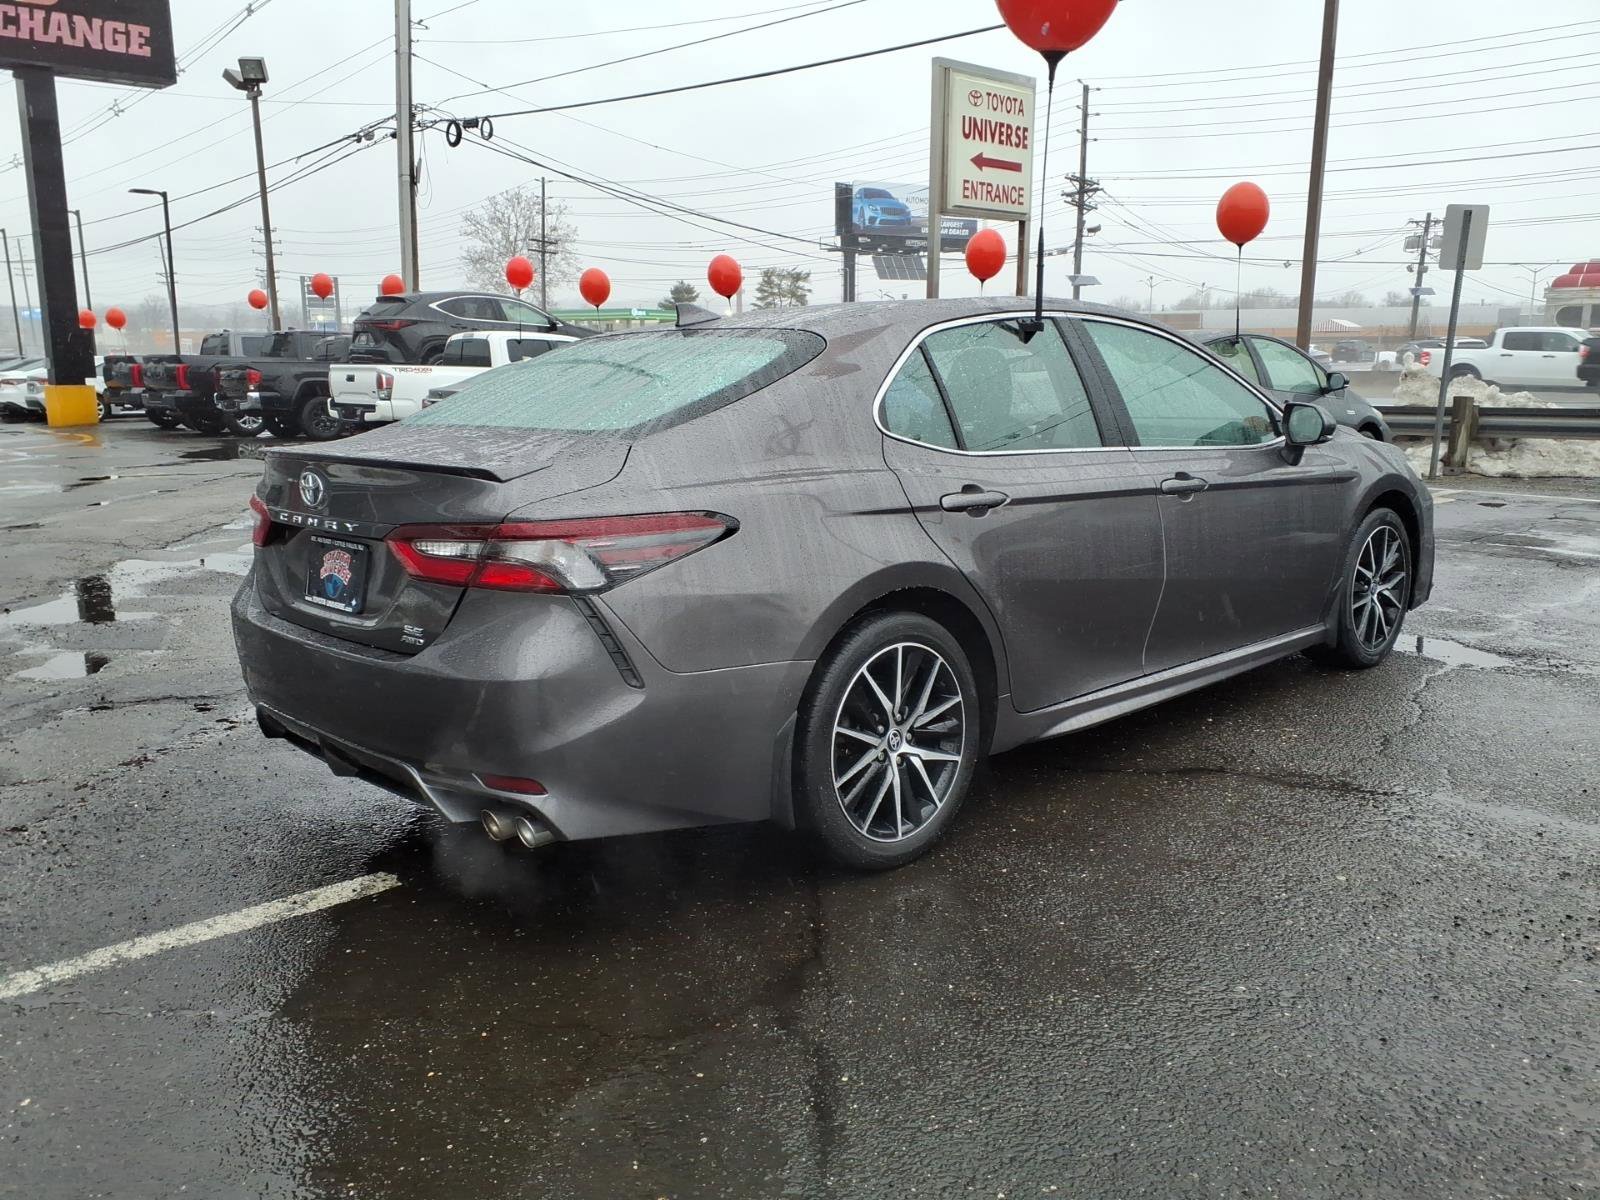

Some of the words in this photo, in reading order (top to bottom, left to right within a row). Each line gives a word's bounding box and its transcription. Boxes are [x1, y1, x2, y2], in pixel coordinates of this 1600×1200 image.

[986, 92, 1024, 117] TOYOTA
[962, 115, 1028, 149] UNIVERSE
[962, 179, 1024, 205] ENTRANCE
[280, 512, 359, 531] CAMRY
[400, 635, 424, 646] AWD
[403, 624, 424, 637] SE
